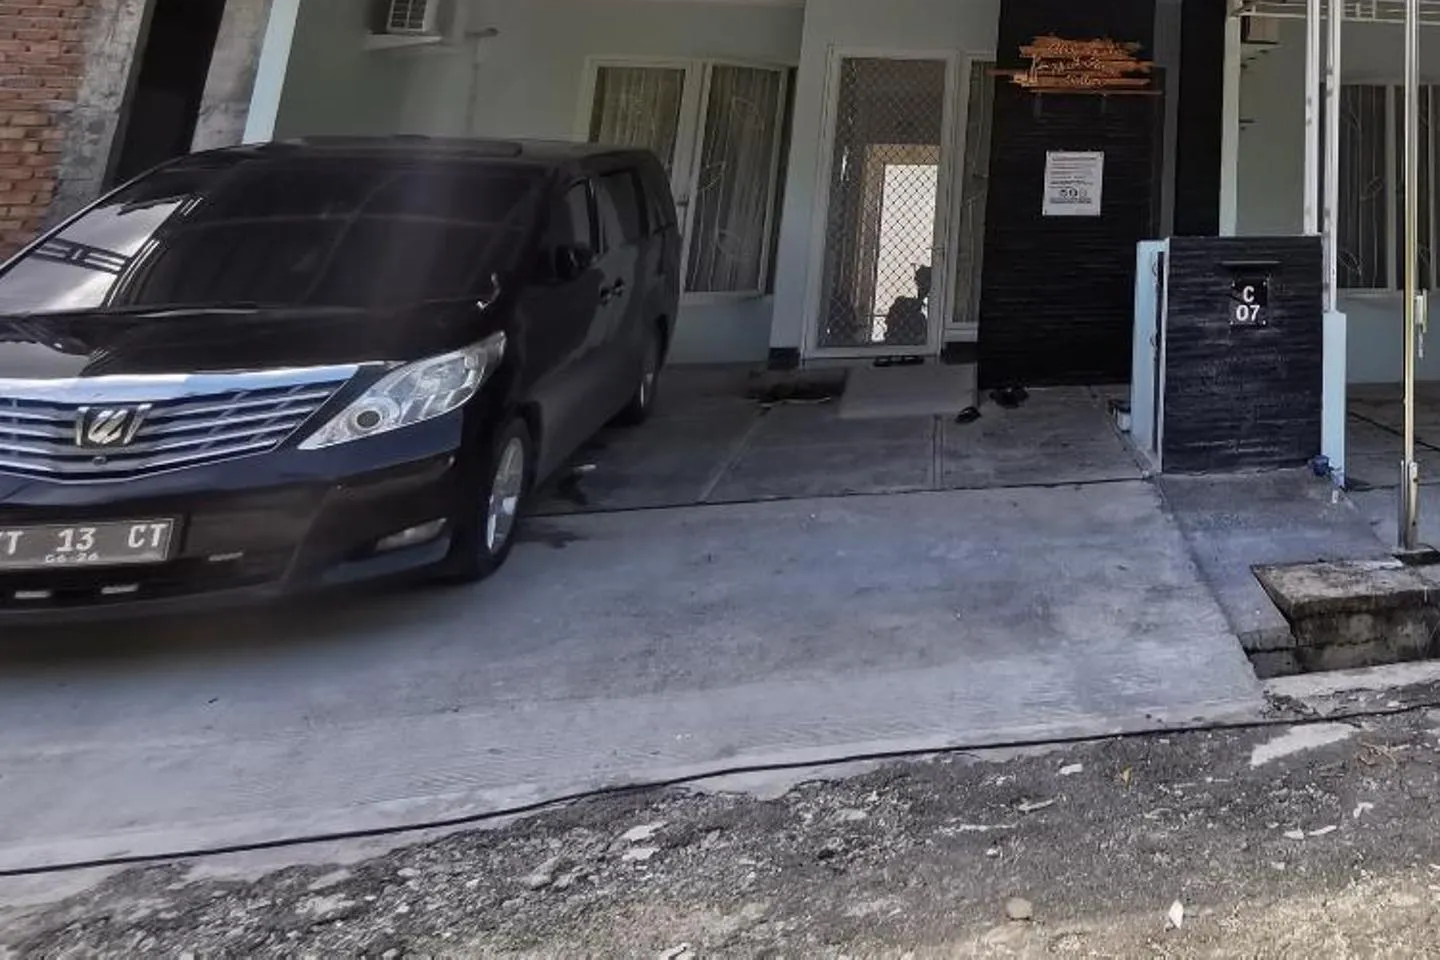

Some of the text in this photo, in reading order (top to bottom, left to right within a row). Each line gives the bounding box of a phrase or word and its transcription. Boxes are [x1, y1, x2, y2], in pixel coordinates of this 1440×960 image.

[1243, 285, 1255, 303] C
[1236, 304, 1260, 321] 07
[0, 523, 169, 555] T 13 CT
